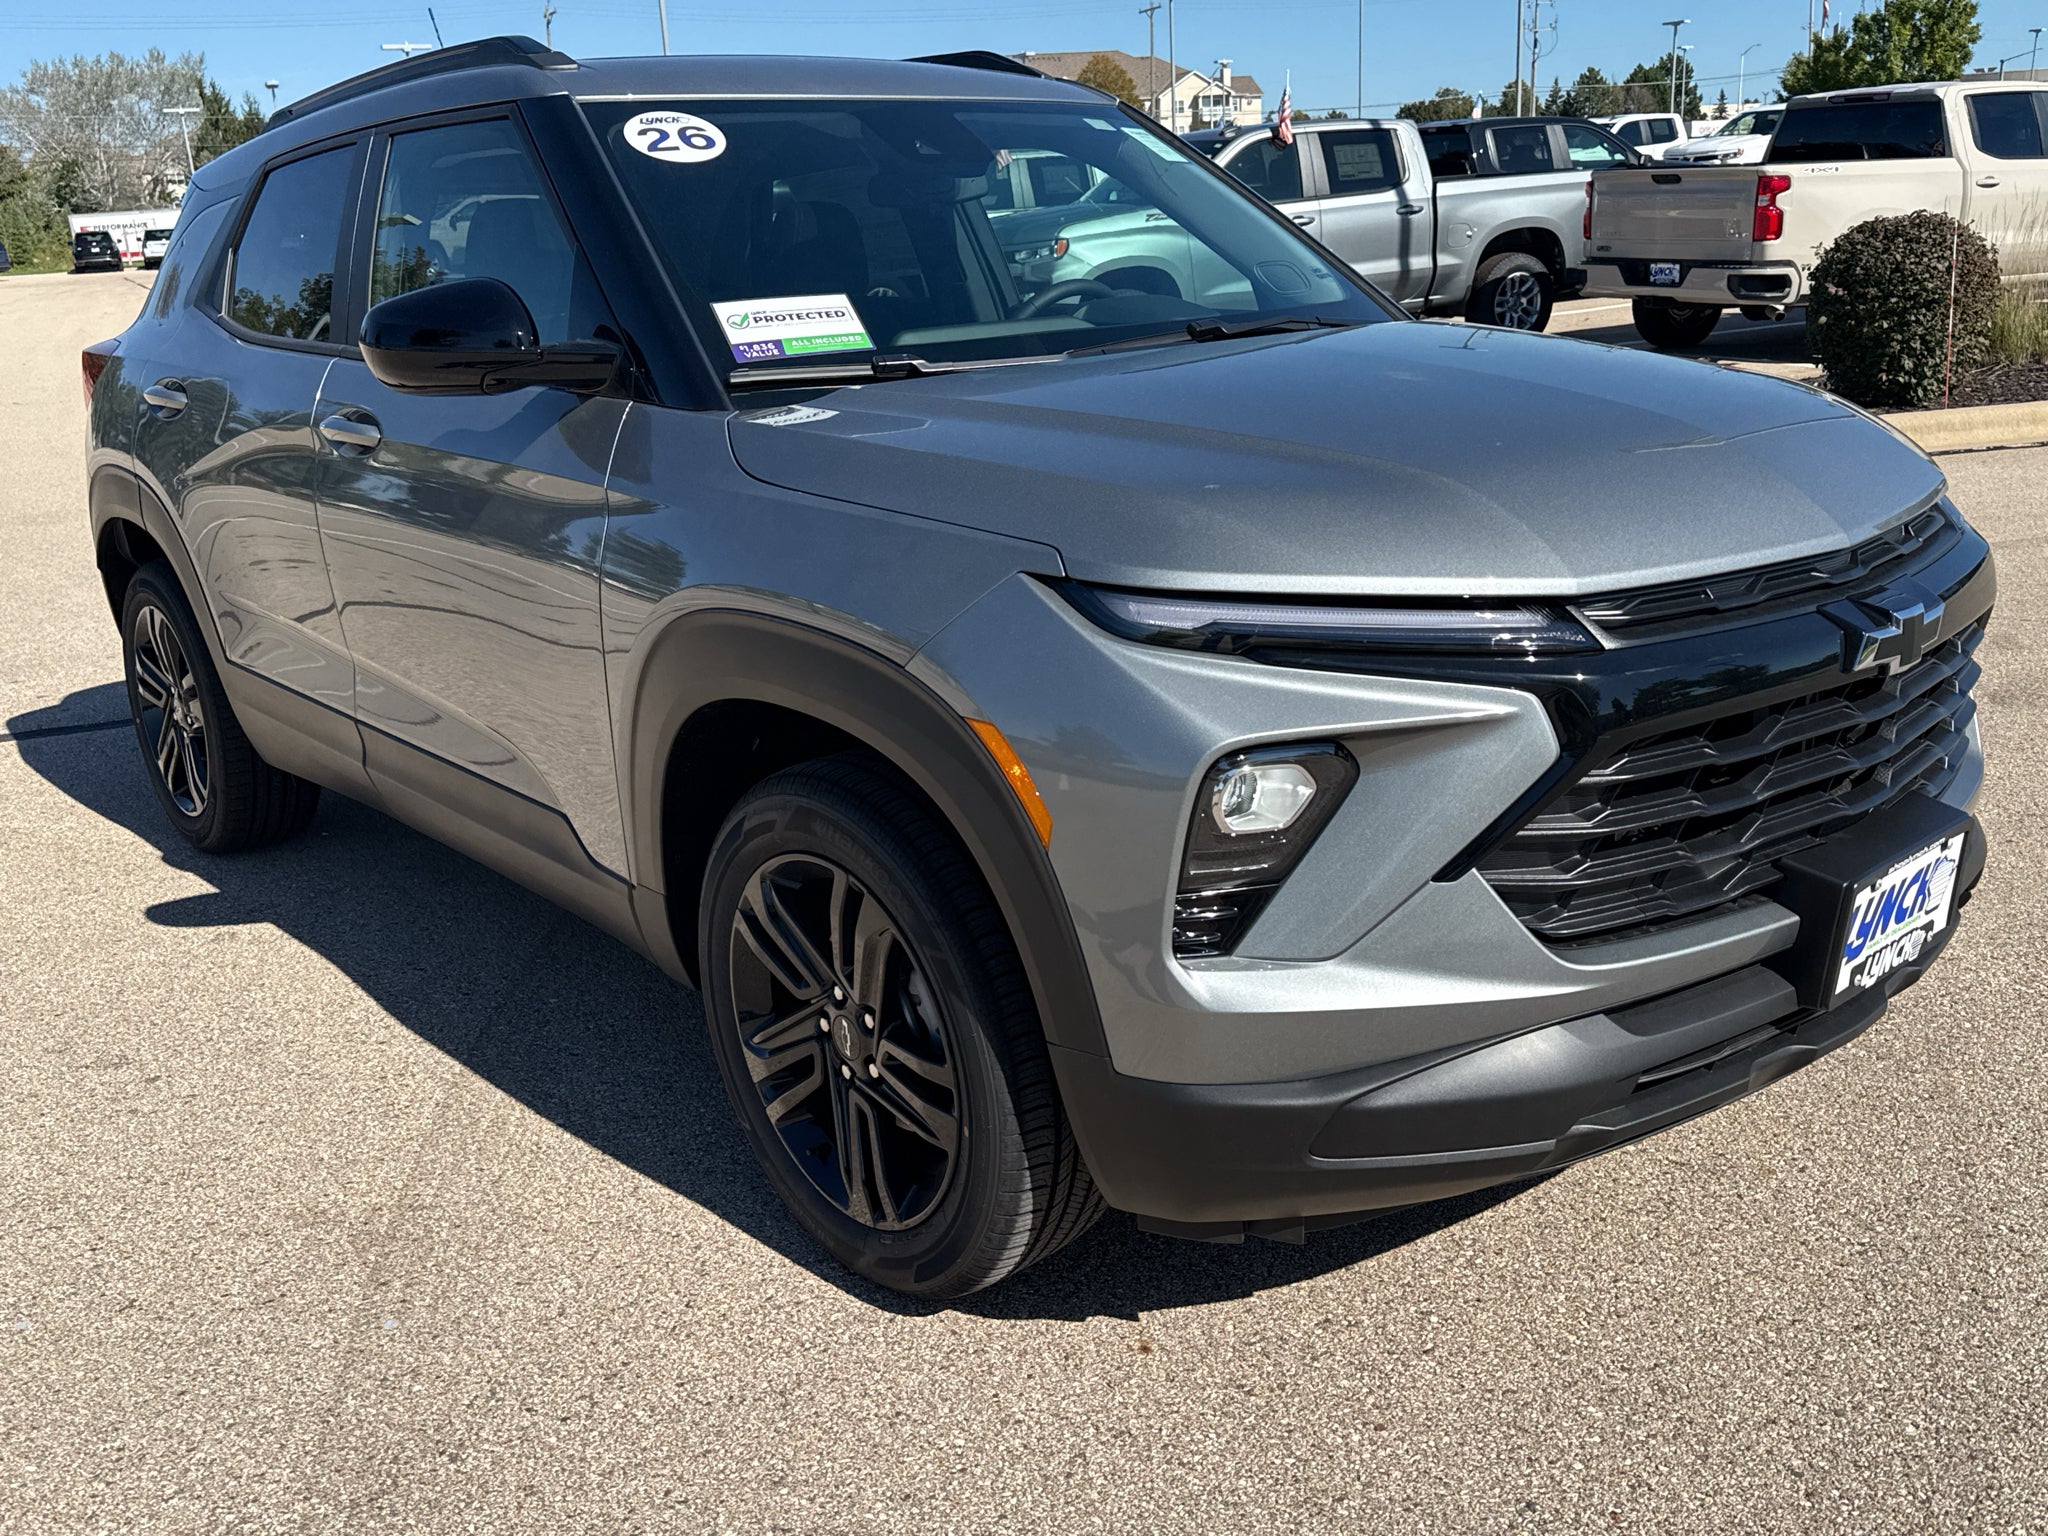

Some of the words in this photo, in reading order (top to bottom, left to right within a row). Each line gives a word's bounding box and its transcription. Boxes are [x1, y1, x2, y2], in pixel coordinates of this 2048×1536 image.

[639, 116, 681, 125] LYNCH
[637, 126, 716, 152] 26
[752, 309, 846, 324] PROTECTED
[791, 339, 811, 347] ALL
[812, 335, 862, 345] INCLUDED
[738, 342, 776, 353] $1,836
[743, 348, 780, 358] VALUE
[1860, 932, 1912, 989] LYNCH
